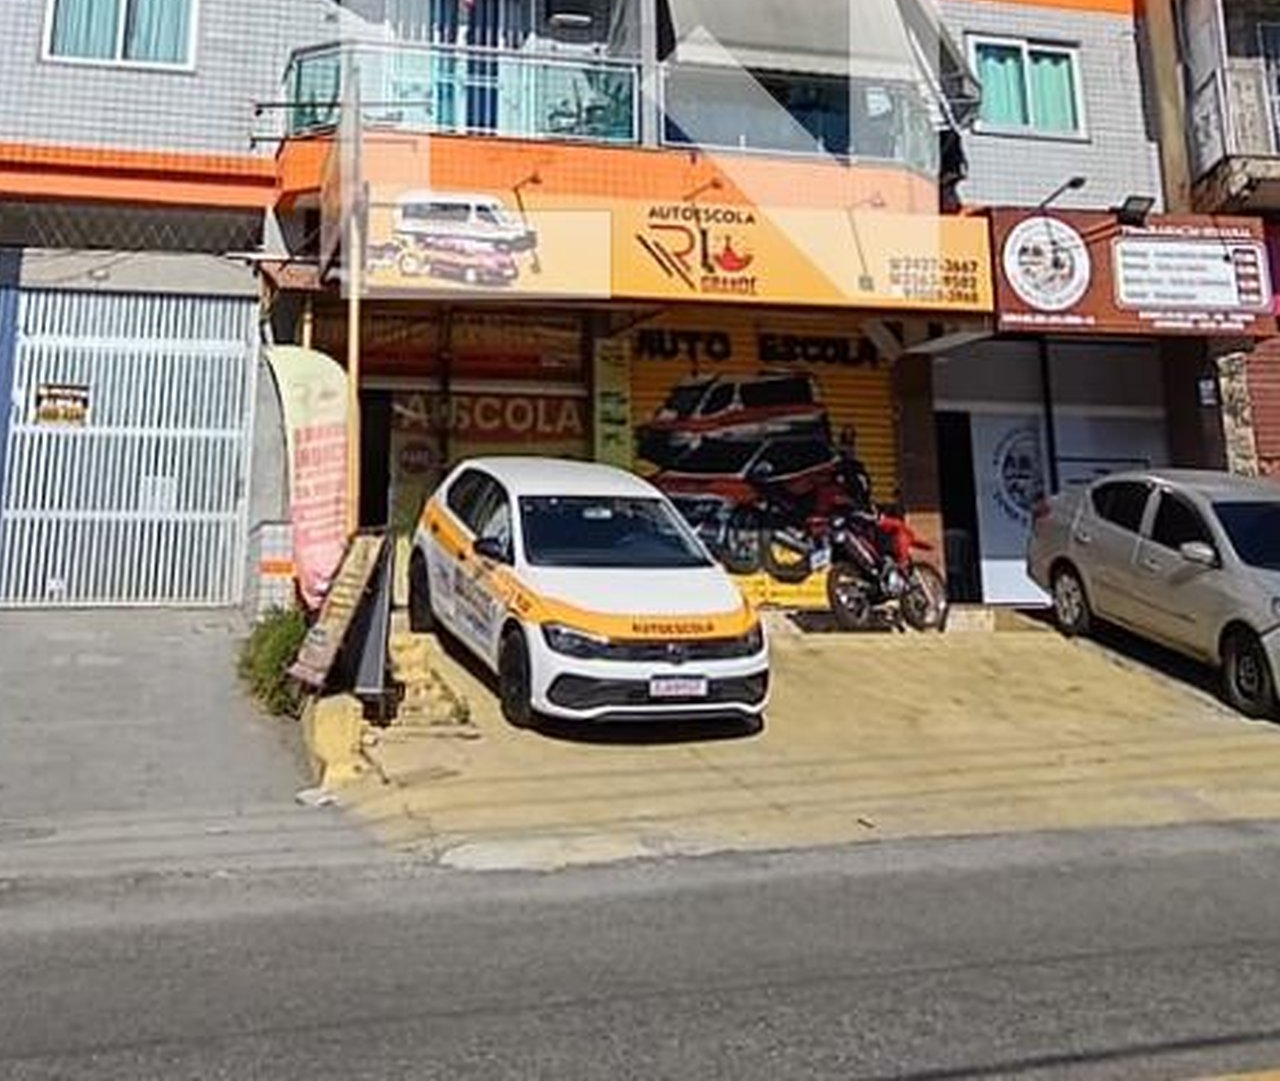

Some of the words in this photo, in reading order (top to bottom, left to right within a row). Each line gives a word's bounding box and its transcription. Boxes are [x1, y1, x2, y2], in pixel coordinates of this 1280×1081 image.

[648, 205, 756, 225] AUTOESCOLA
[634, 327, 732, 360] AUTO
[757, 330, 879, 366] ESCOLA
